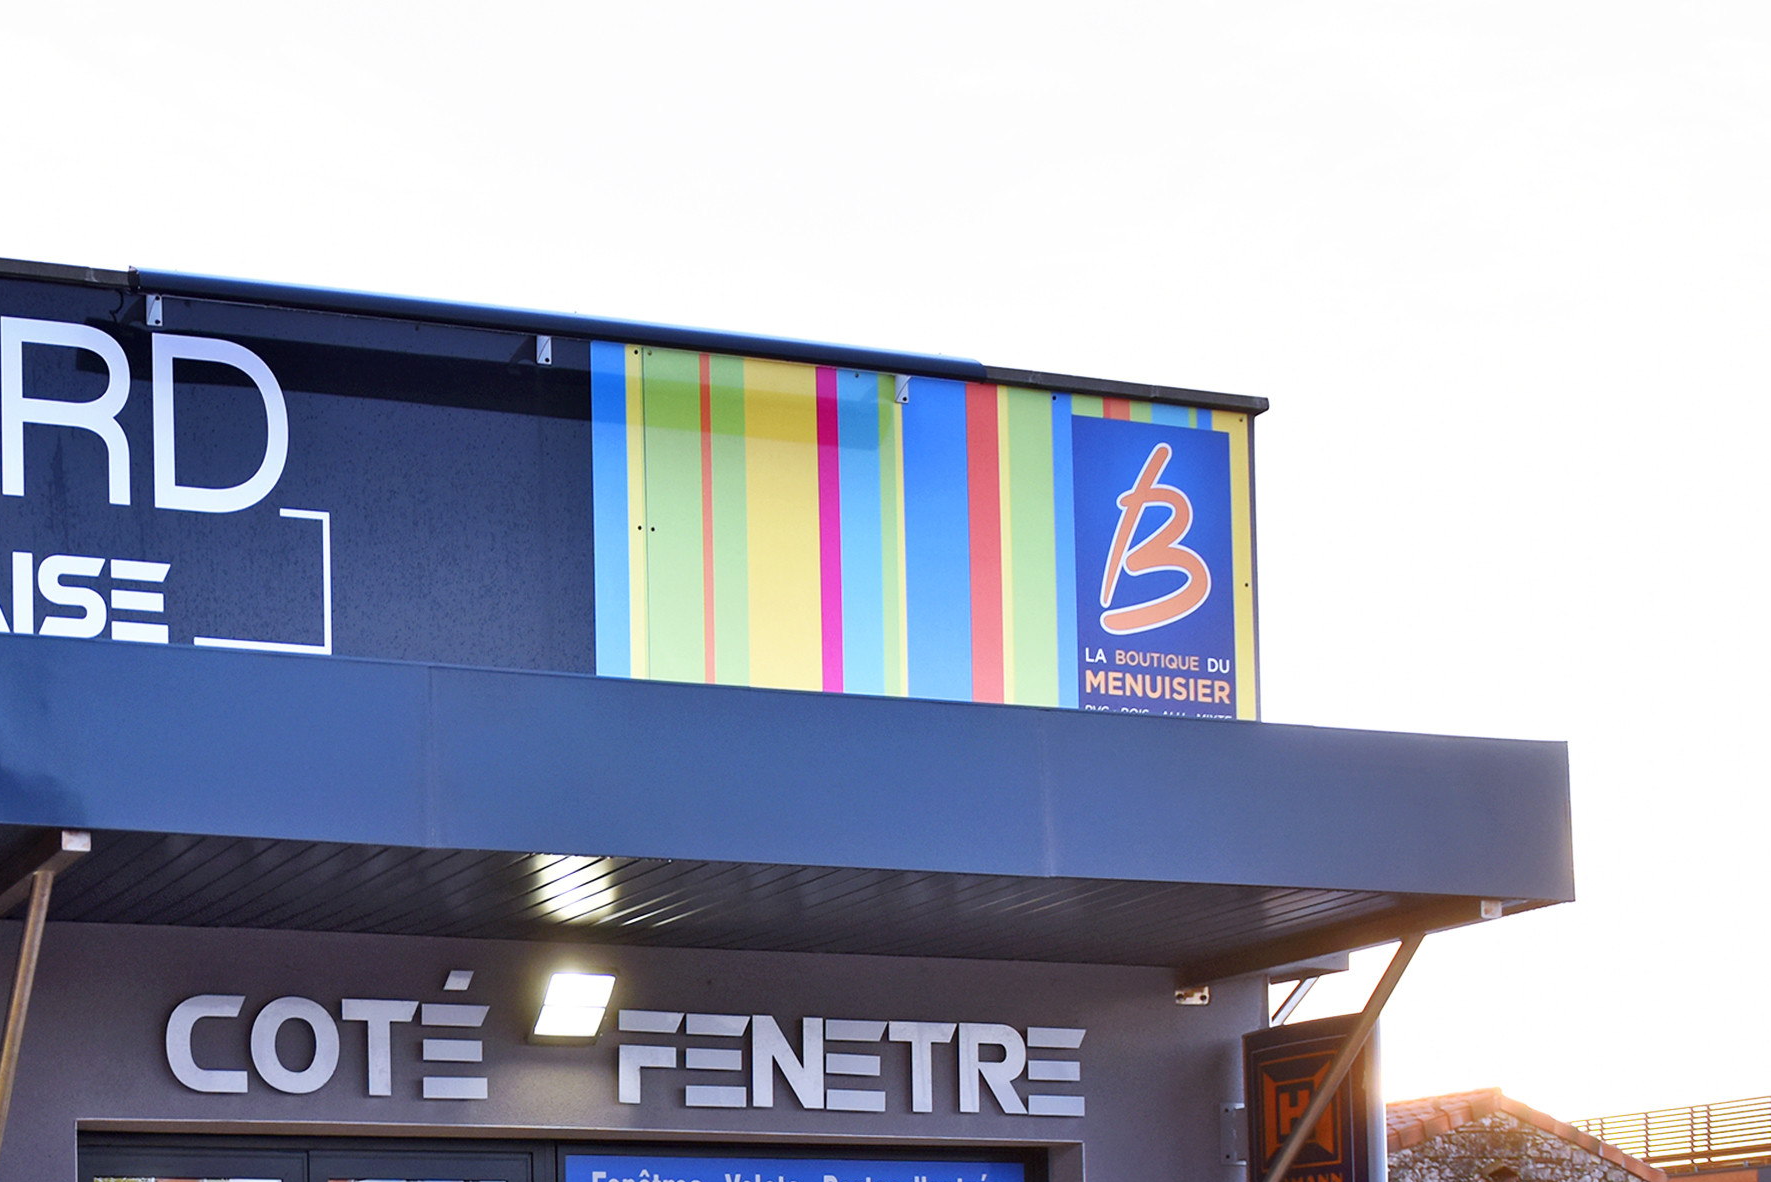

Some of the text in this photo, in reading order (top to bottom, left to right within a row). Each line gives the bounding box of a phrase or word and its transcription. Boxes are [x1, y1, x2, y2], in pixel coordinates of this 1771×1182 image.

[1084, 647, 1231, 674] LA BOUTIQUE DU
[1085, 669, 1231, 704] MENUISIER
[165, 969, 1087, 1117] COTÉ FENETRE
